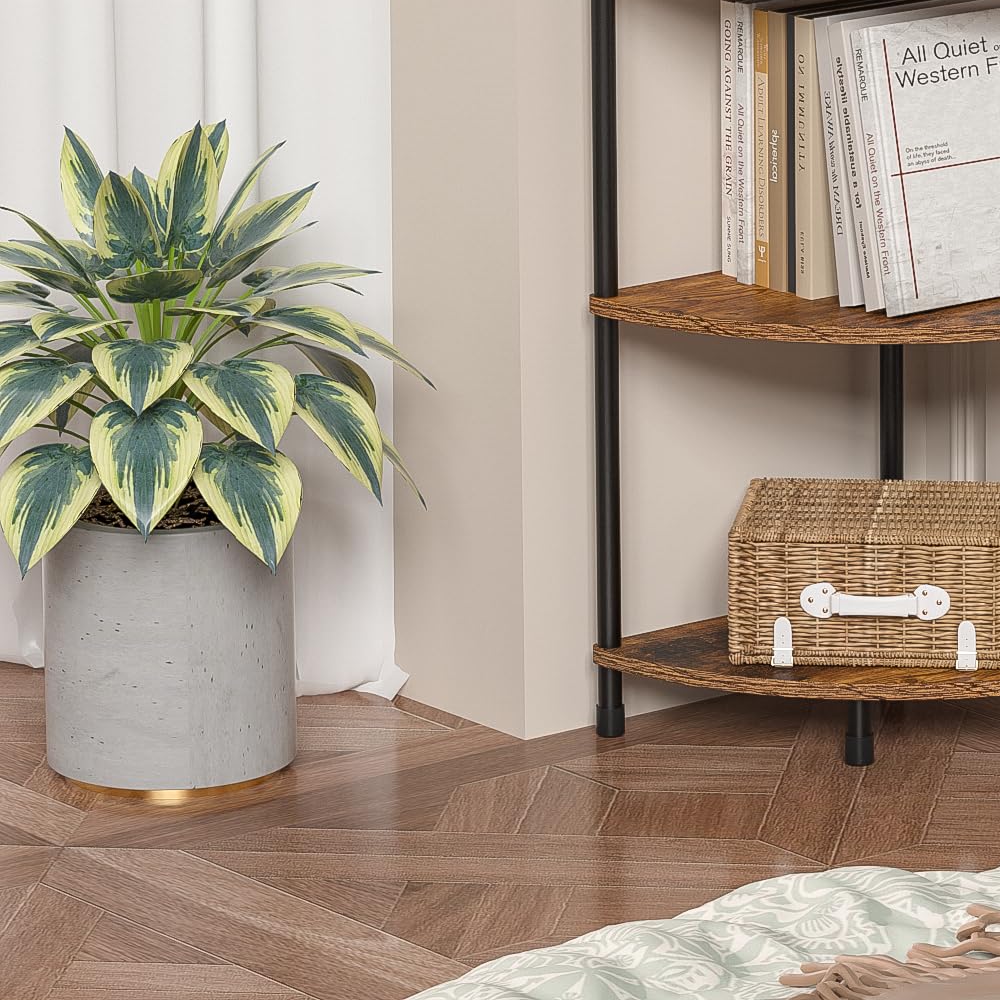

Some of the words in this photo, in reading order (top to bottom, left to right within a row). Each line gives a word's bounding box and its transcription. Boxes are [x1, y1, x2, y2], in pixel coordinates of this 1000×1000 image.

[724, 19, 732, 62] GOING
[736, 20, 744, 74] REMARQUE
[901, 44, 927, 66] All
[933, 35, 988, 60] Quiet
[855, 48, 869, 103] REMARQUE
[894, 64, 980, 89] Western
[724, 65, 732, 123] AGAINST
[737, 103, 745, 117] All
[725, 126, 733, 151] THE
[737, 118, 745, 145] Quiet
[866, 132, 875, 147] All
[737, 146, 744, 158] on
[924, 141, 949, 151] threshold
[737, 160, 745, 176] the
[868, 147, 878, 175] Quiet
[725, 155, 733, 197] GRAIN
[871, 175, 878, 189] on
[758, 177, 766, 238] DISORDERS
[874, 190, 882, 206] the
[738, 218, 746, 244] Front
[876, 207, 888, 249] Western
[881, 250, 891, 276] Front
